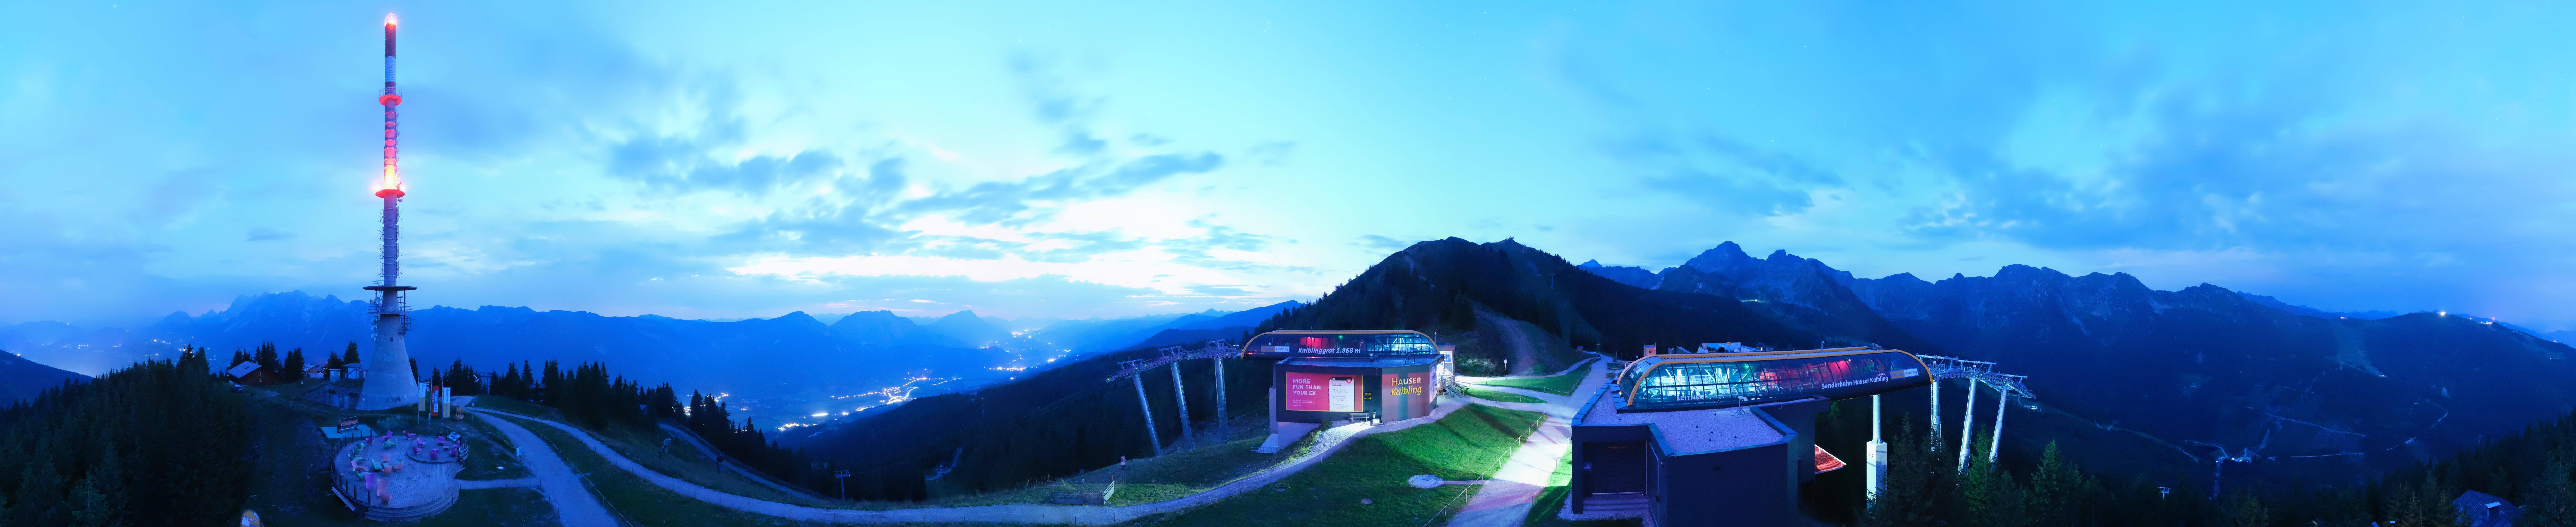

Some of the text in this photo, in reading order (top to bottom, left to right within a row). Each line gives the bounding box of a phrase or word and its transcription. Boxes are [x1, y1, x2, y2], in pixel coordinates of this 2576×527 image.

[1392, 377, 1421, 386] HAUSER
[1822, 380, 1852, 389] Senderbahn
[1391, 386, 1422, 396] Kaibling
